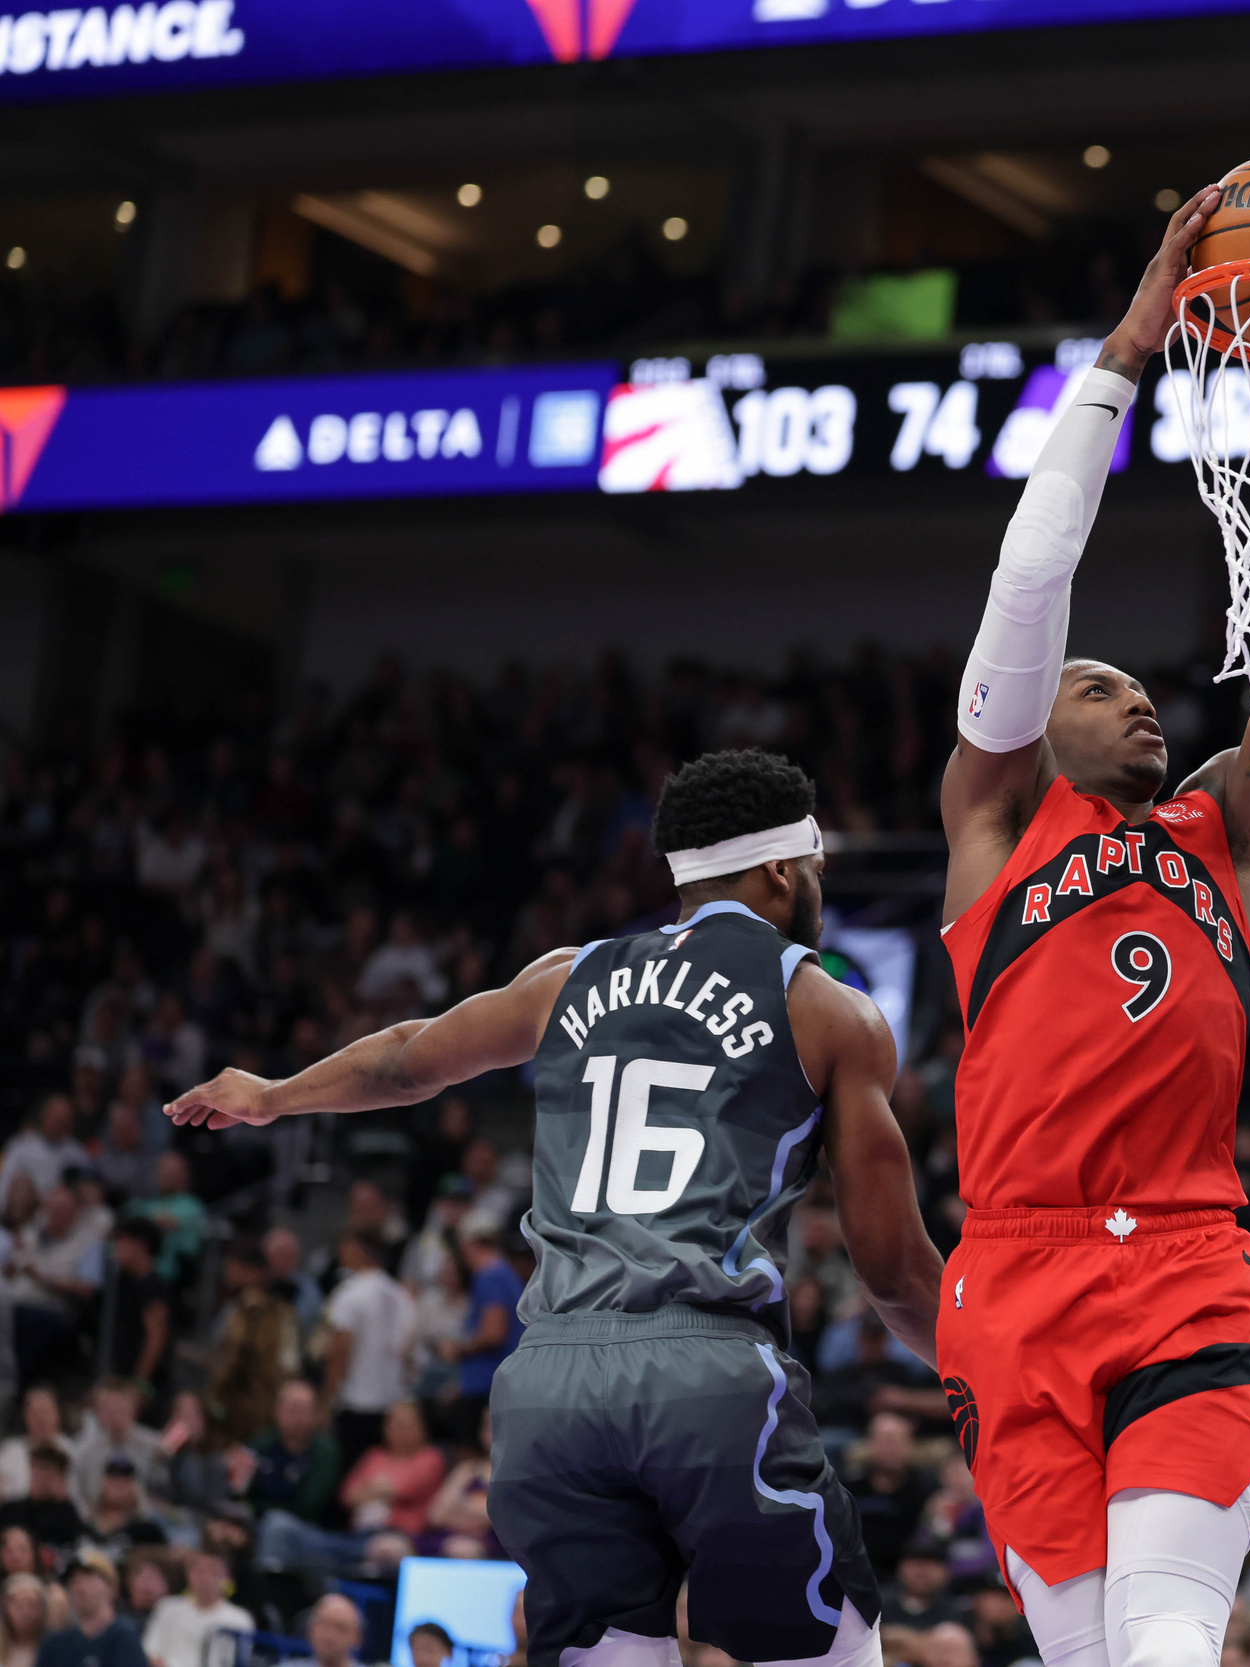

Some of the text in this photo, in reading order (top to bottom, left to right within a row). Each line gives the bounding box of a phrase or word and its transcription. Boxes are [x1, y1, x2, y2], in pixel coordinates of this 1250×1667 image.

[307, 407, 482, 465] DELTA
[733, 380, 981, 477] 103 74
[1181, 809, 1204, 820] Life
[1022, 831, 1234, 962] RAPTORS
[559, 959, 775, 1059] HARKLESS
[1110, 930, 1172, 1023] 9
[570, 1055, 717, 1215] 16
